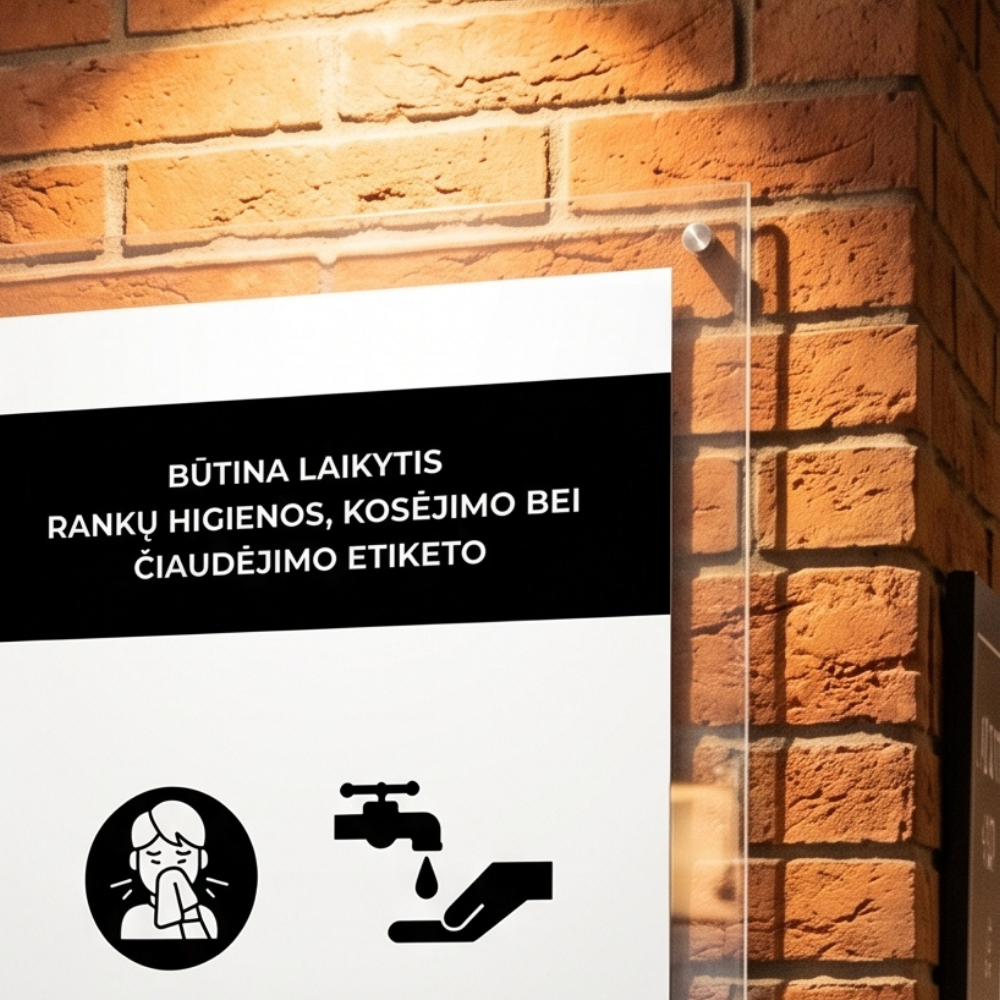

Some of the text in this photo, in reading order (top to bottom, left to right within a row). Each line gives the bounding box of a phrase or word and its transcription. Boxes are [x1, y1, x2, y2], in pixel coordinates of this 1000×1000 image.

[169, 448, 443, 488] BŪTINA LAIKYTIS
[48, 487, 580, 542] RANKŲ HIGIENOS, KOSĖJIMO BEI
[133, 539, 487, 580] ČIAUDĖJIMO ETIKETO
